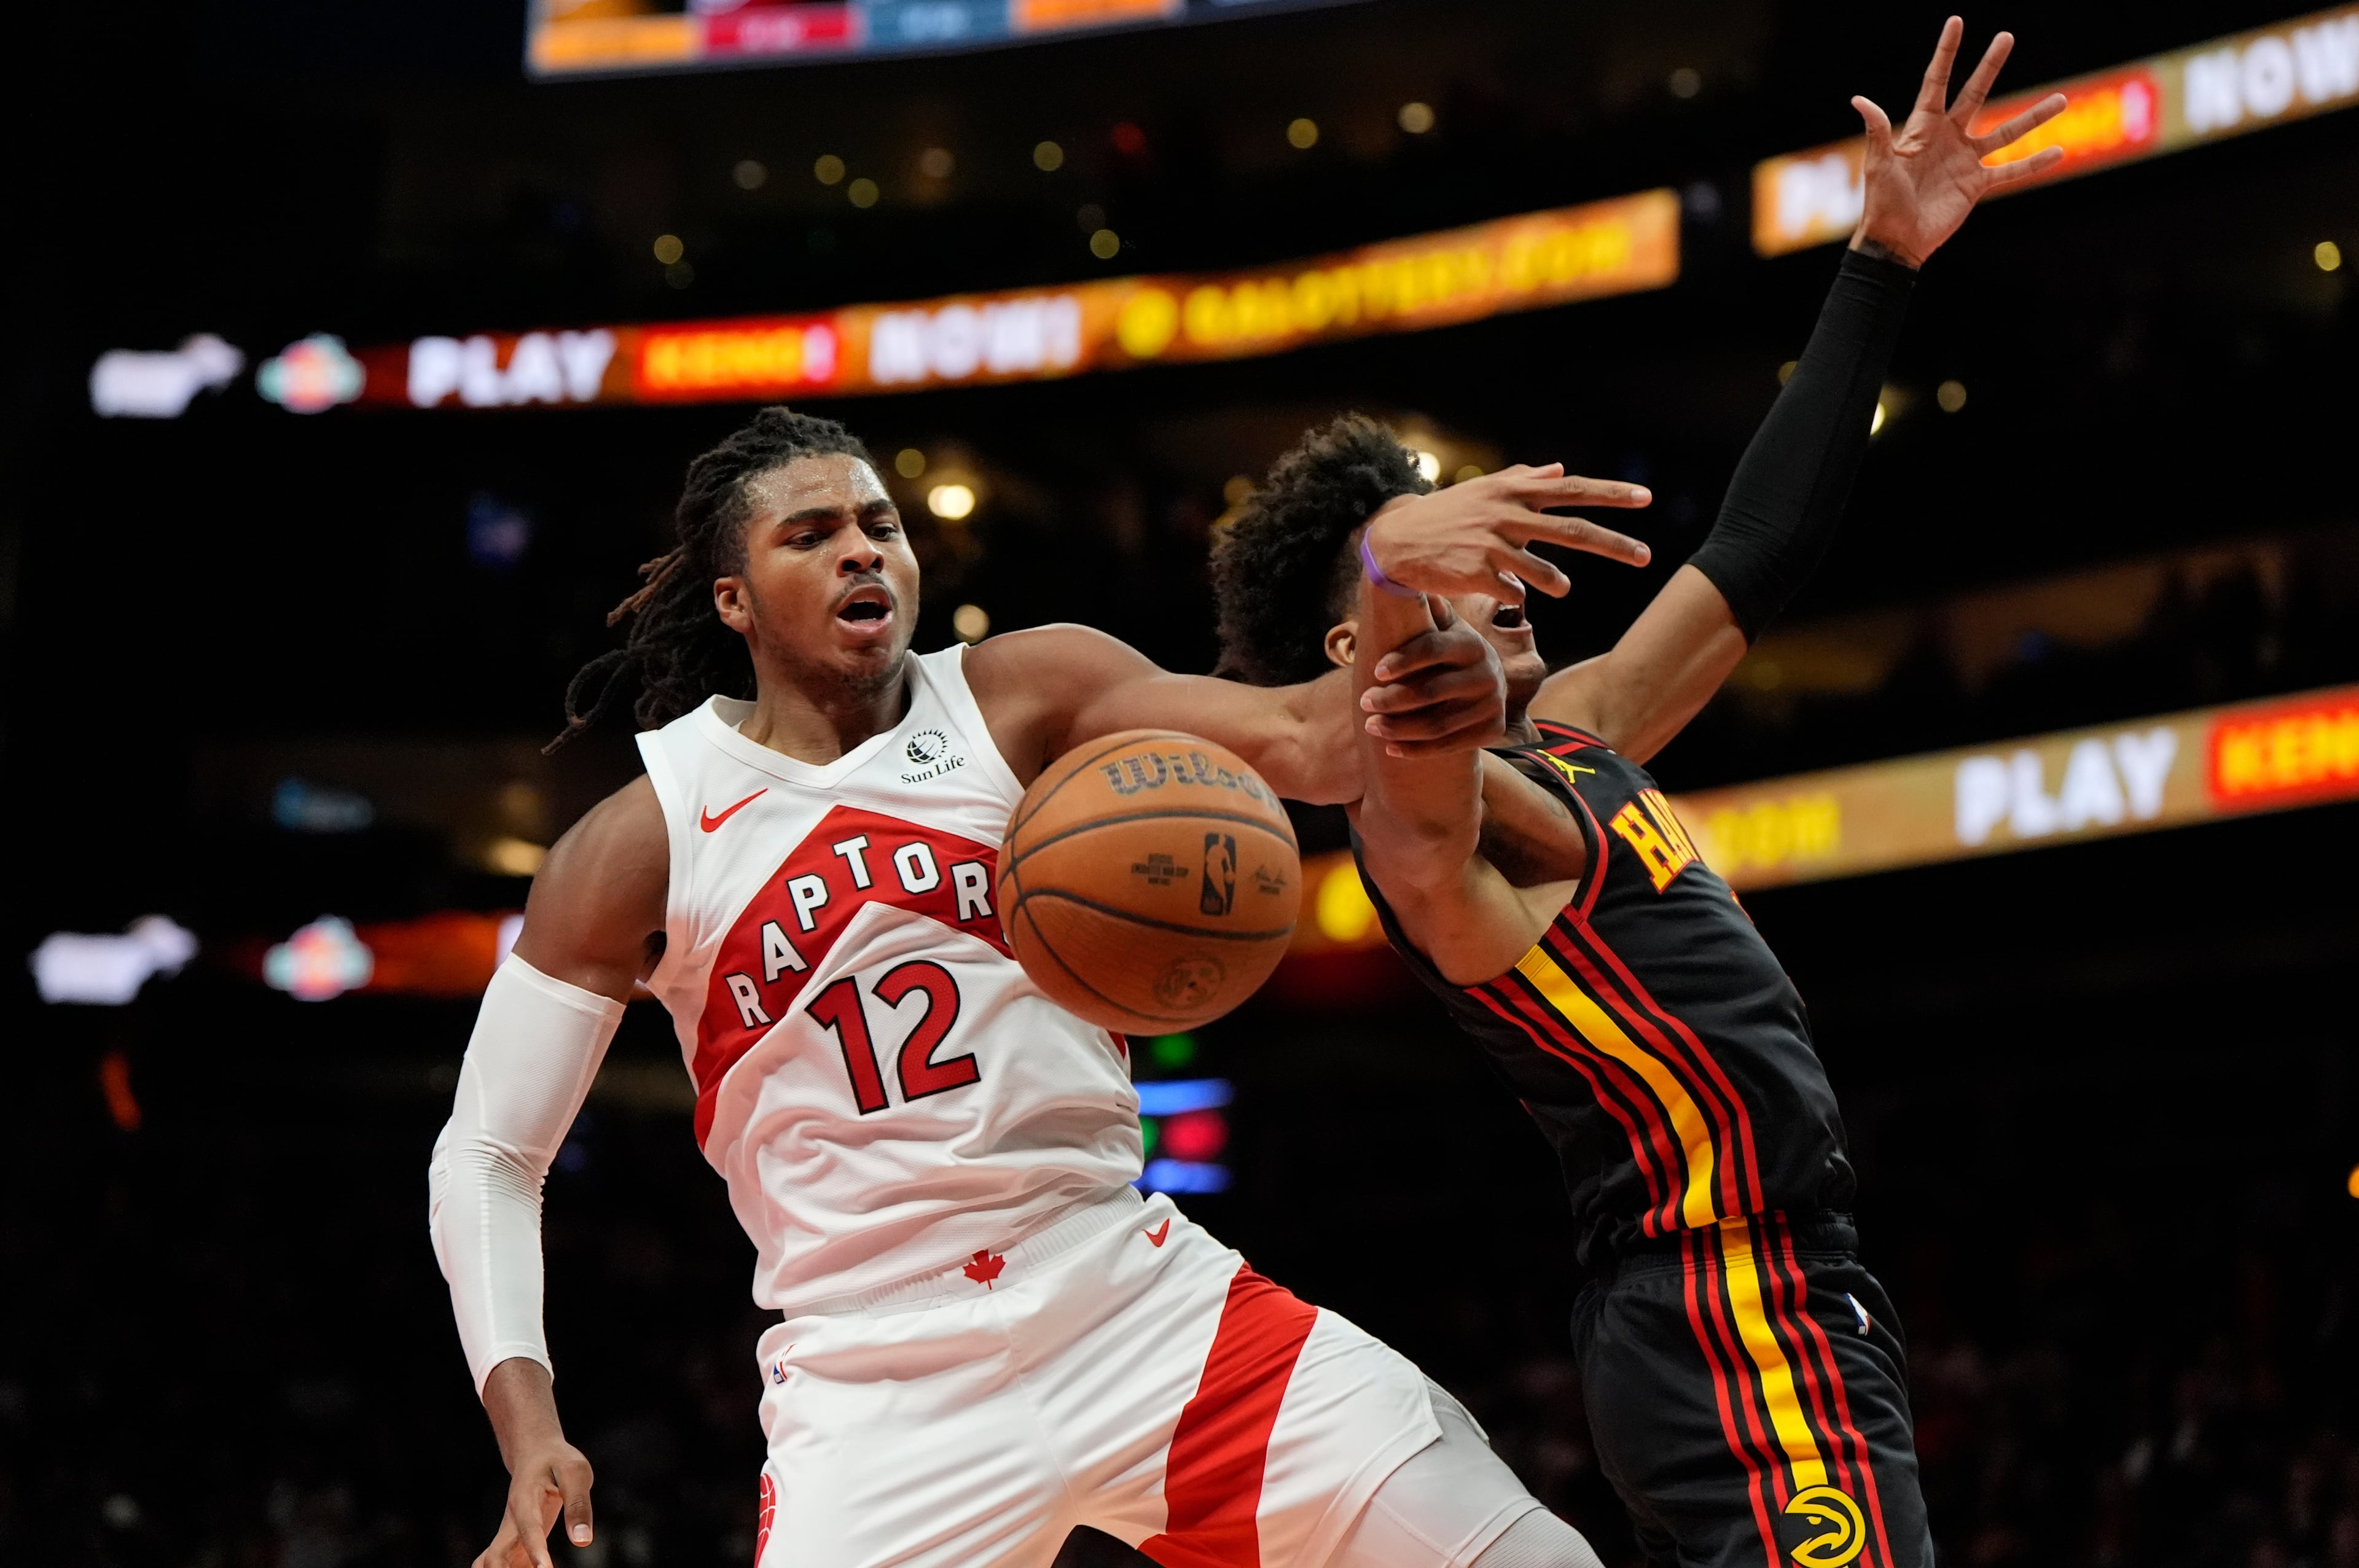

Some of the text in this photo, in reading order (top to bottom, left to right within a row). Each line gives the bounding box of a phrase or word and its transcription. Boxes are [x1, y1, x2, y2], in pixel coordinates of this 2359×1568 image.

[409, 329, 616, 407] PLAY
[901, 755, 966, 784] Sun Life
[1955, 728, 2180, 846] PLAY
[725, 833, 1007, 1031] RAPTOR
[804, 958, 982, 1116] 12
